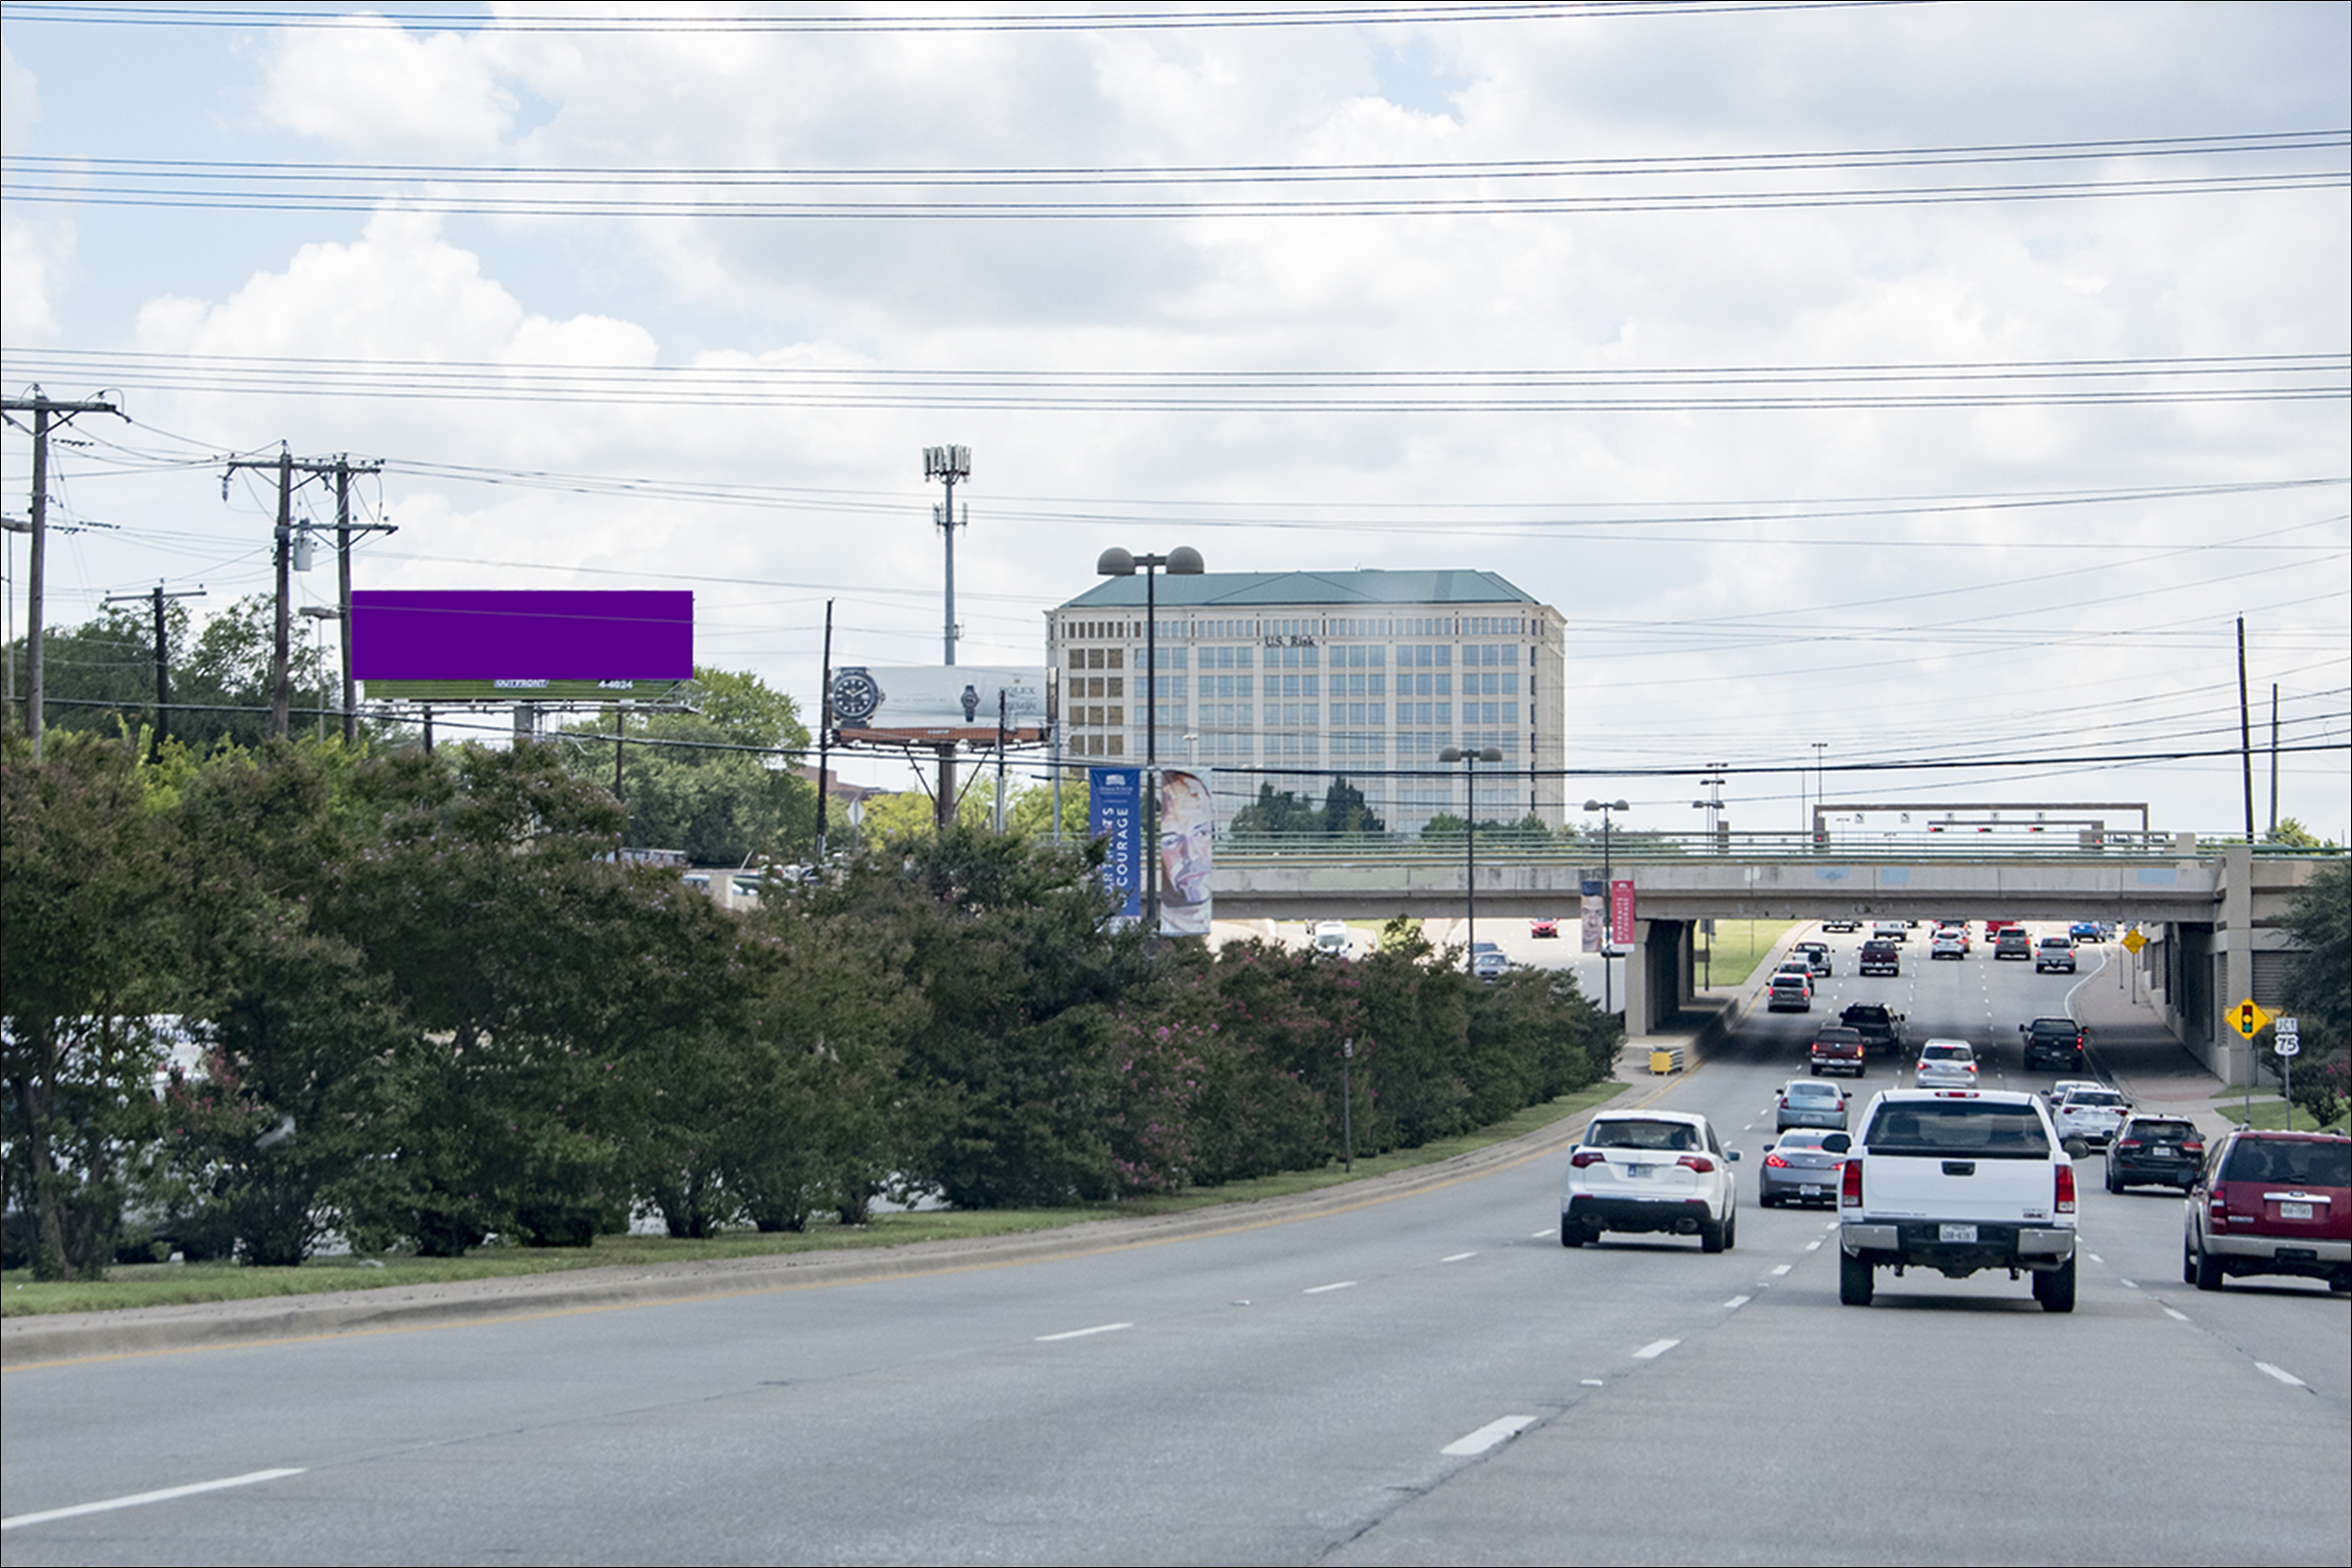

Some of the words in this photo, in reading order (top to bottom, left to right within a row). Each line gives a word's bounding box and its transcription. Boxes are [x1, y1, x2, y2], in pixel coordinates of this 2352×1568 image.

[1291, 635, 1316, 648] Risk
[494, 679, 549, 688] OUTFRONT
[1116, 808, 1128, 887] COURAGE
[2278, 1019, 2295, 1030] JCT
[2278, 1037, 2297, 1052] 75
